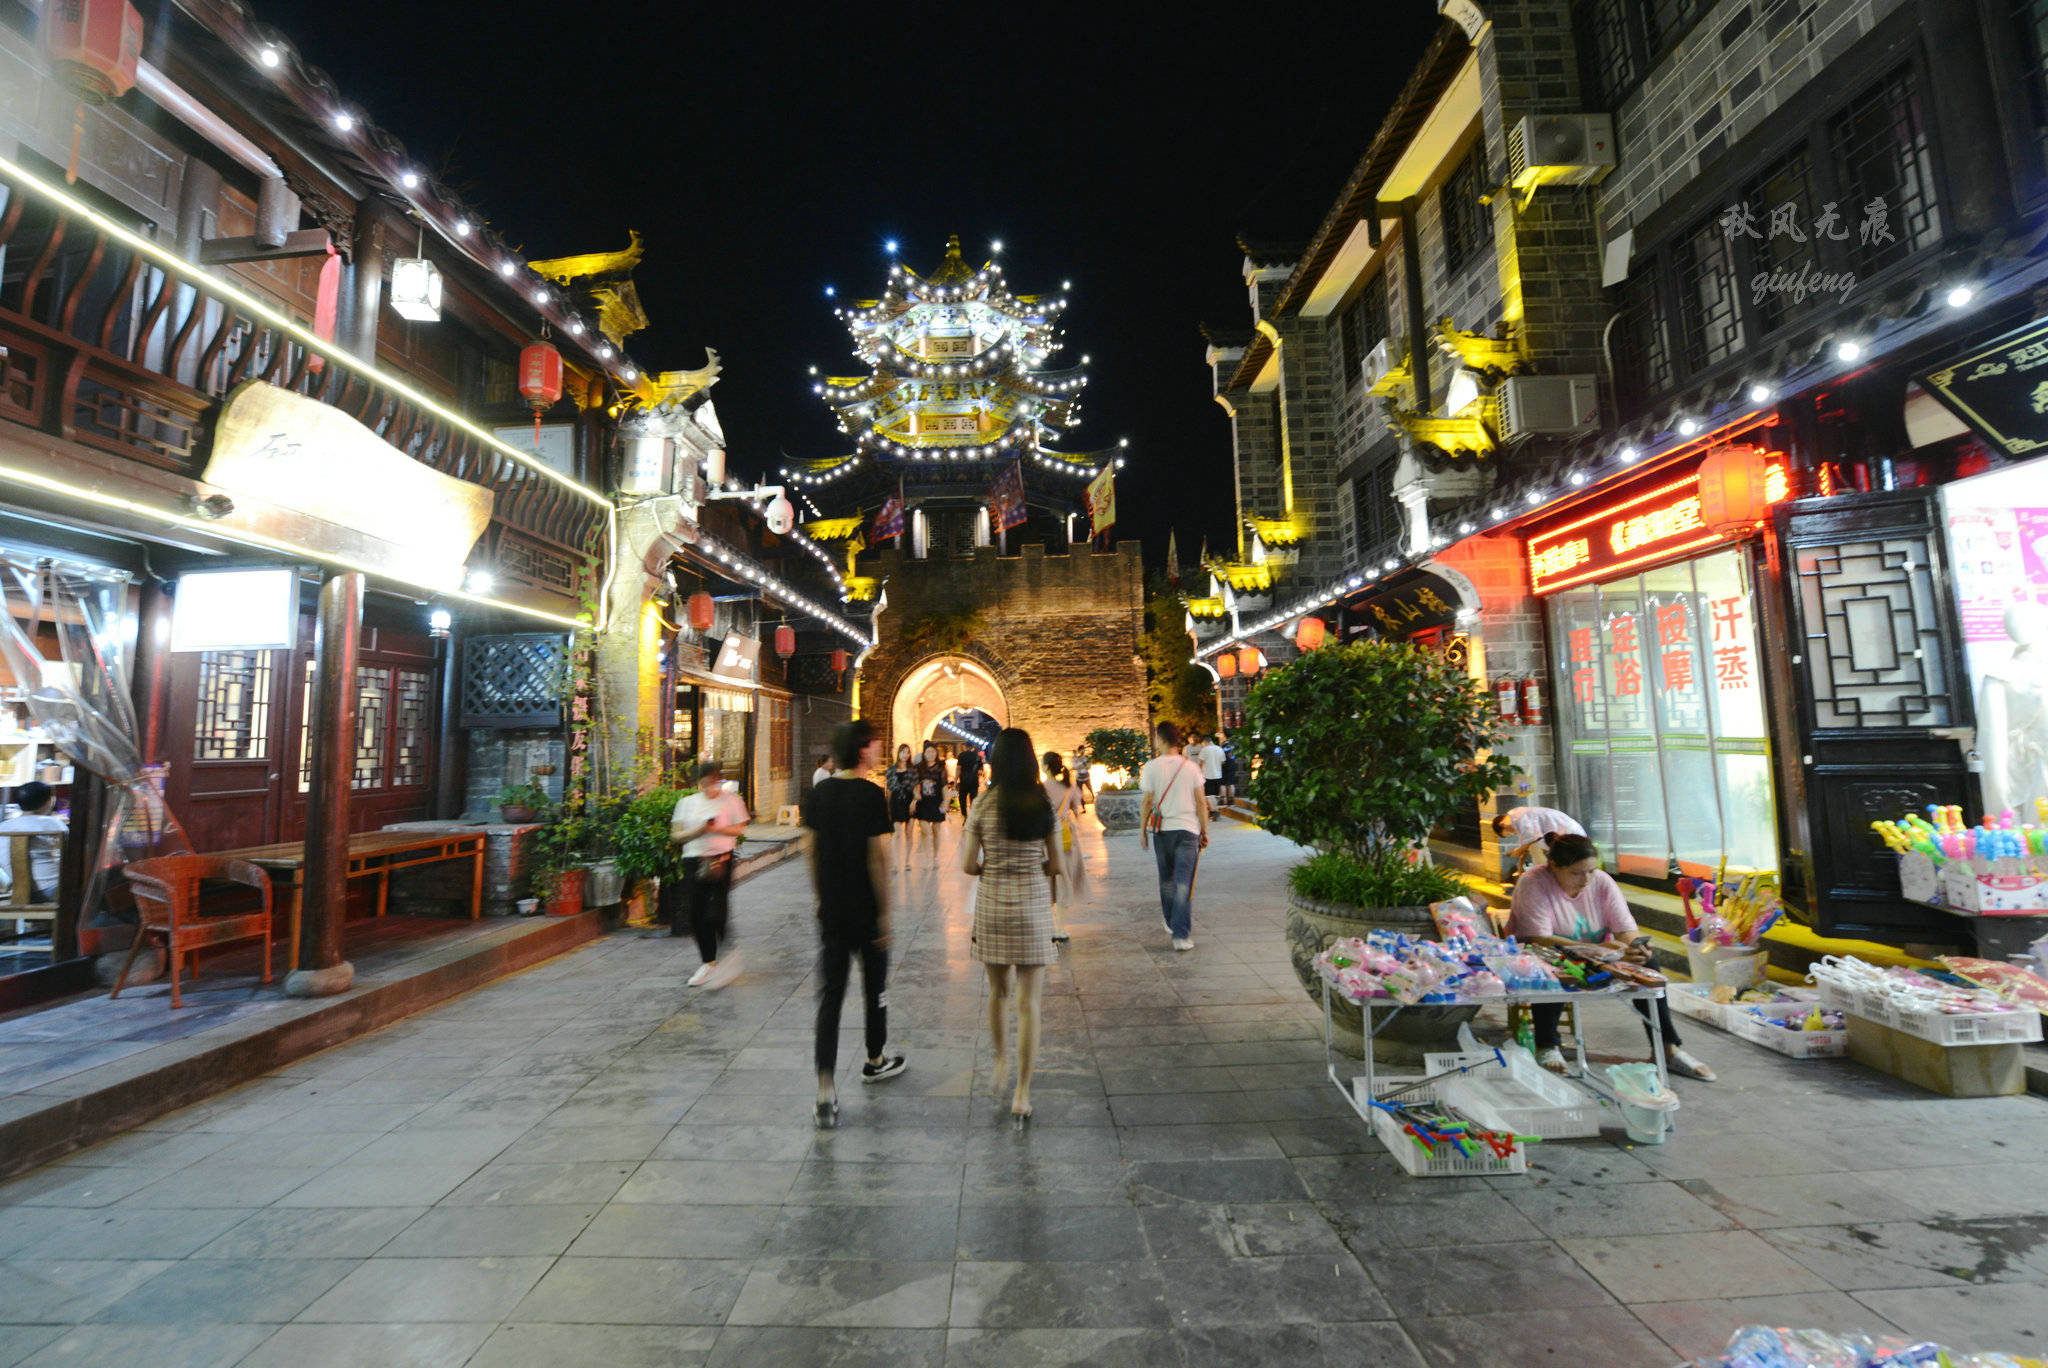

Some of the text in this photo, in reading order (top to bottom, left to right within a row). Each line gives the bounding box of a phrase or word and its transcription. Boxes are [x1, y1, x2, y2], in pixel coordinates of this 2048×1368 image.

[1568, 628, 1596, 703] 理疗
[1610, 615, 1643, 697] 足浴
[1655, 602, 1694, 692] 按摩
[1710, 596, 1750, 690] 汗蒸
